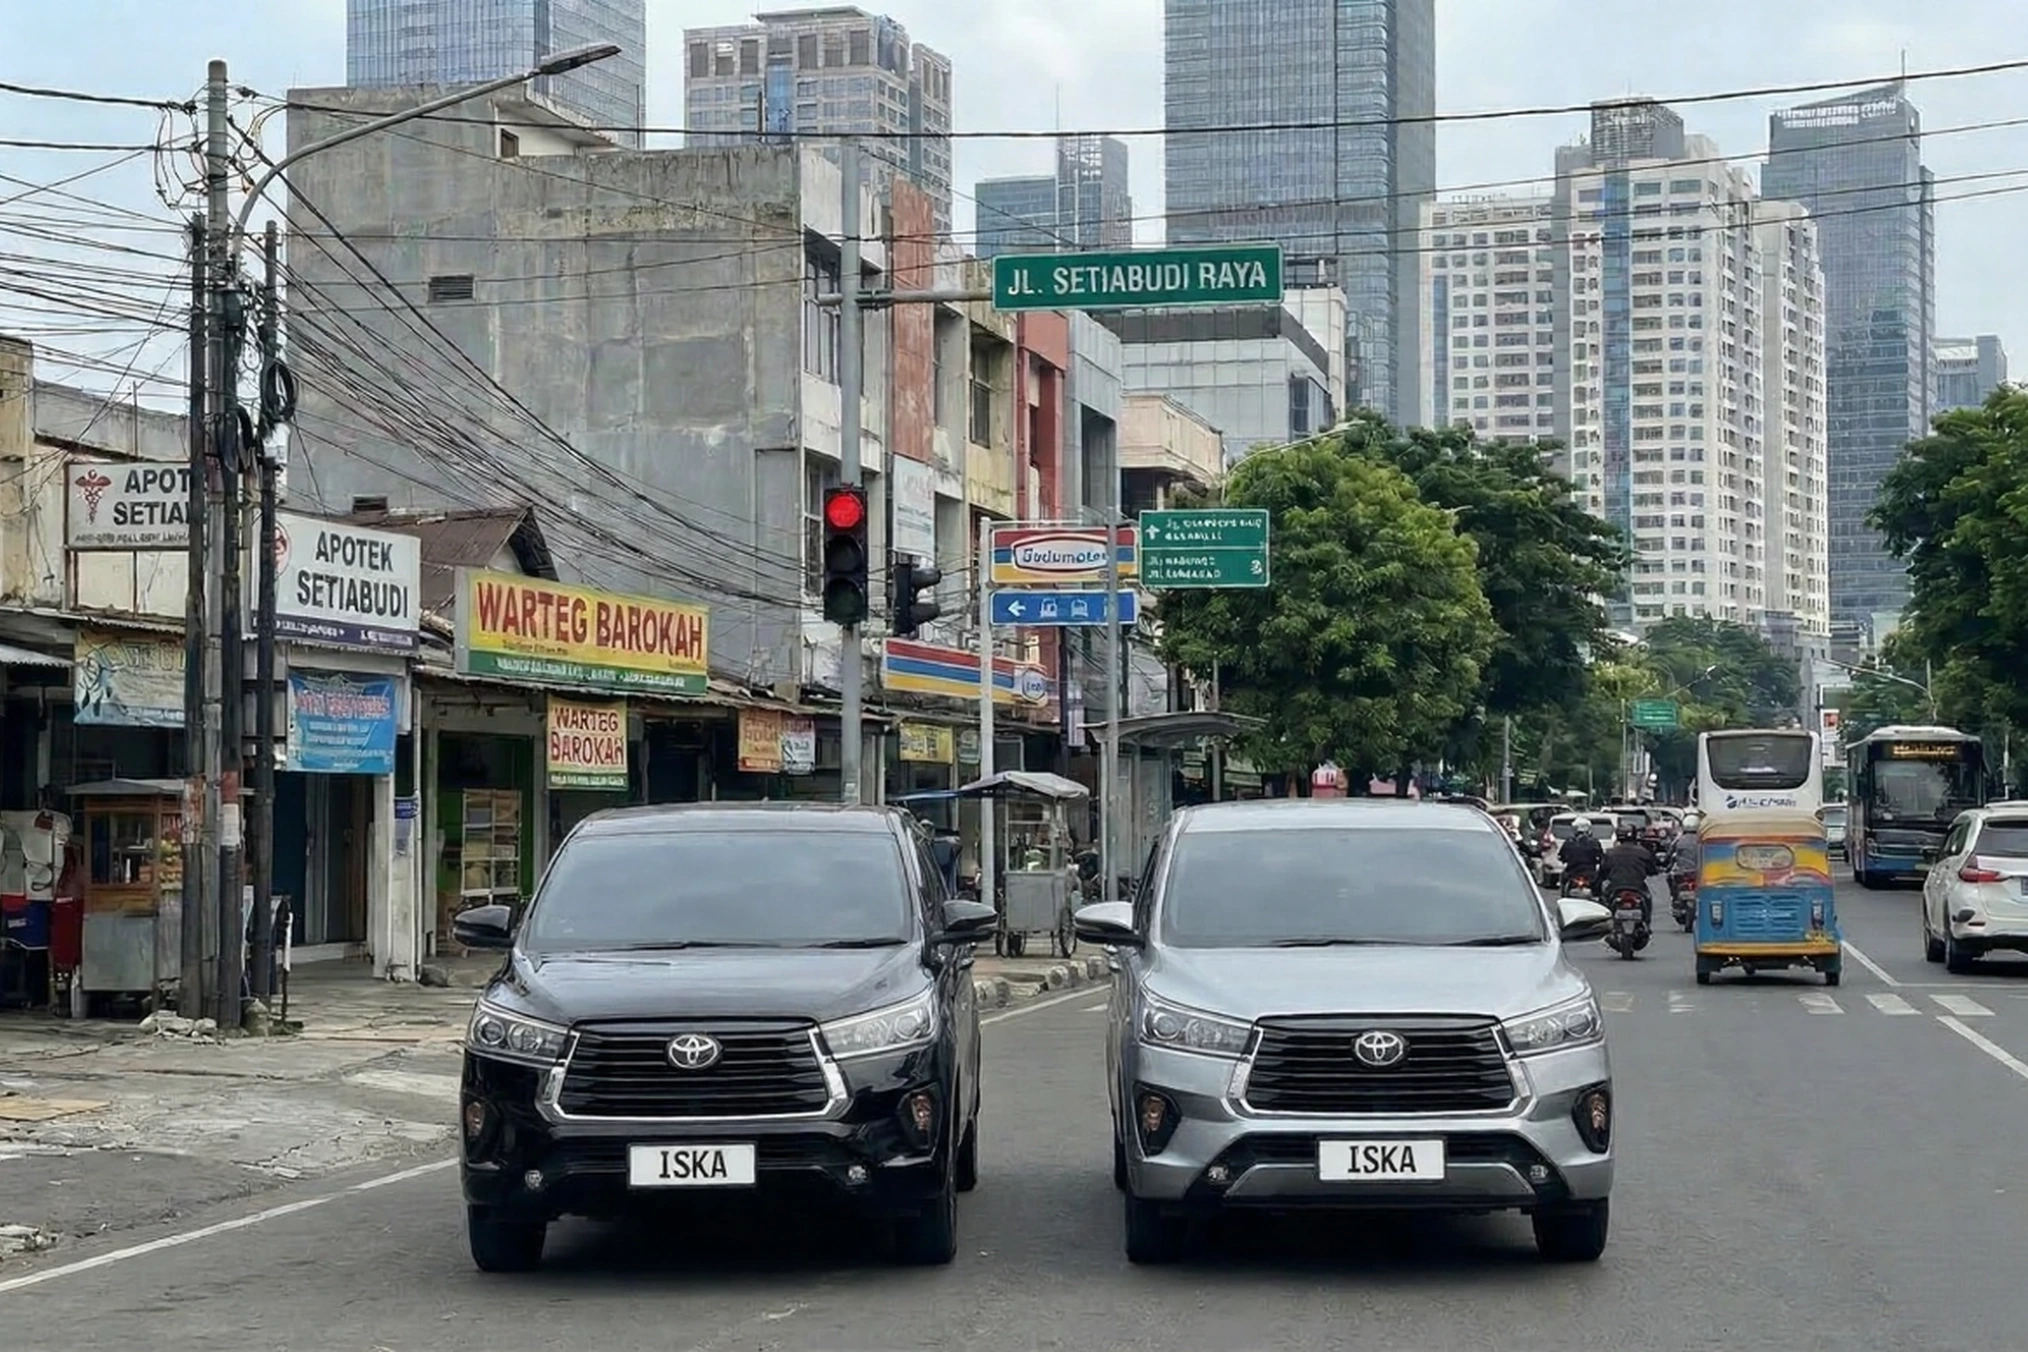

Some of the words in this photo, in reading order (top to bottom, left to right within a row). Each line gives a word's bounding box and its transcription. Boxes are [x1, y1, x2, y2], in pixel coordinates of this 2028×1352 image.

[1007, 269, 1043, 295] JL.
[1053, 263, 1189, 295] SETIABUDI
[1199, 260, 1267, 290] RAYA
[315, 530, 394, 573] APOTEK
[297, 569, 408, 619] SETIABUDI
[477, 582, 588, 644] WARTEG
[596, 601, 703, 660] BAROKAH
[554, 707, 619, 732] WARTEG
[659, 1150, 728, 1179] ISKA
[1348, 1145, 1417, 1174] ISKA
